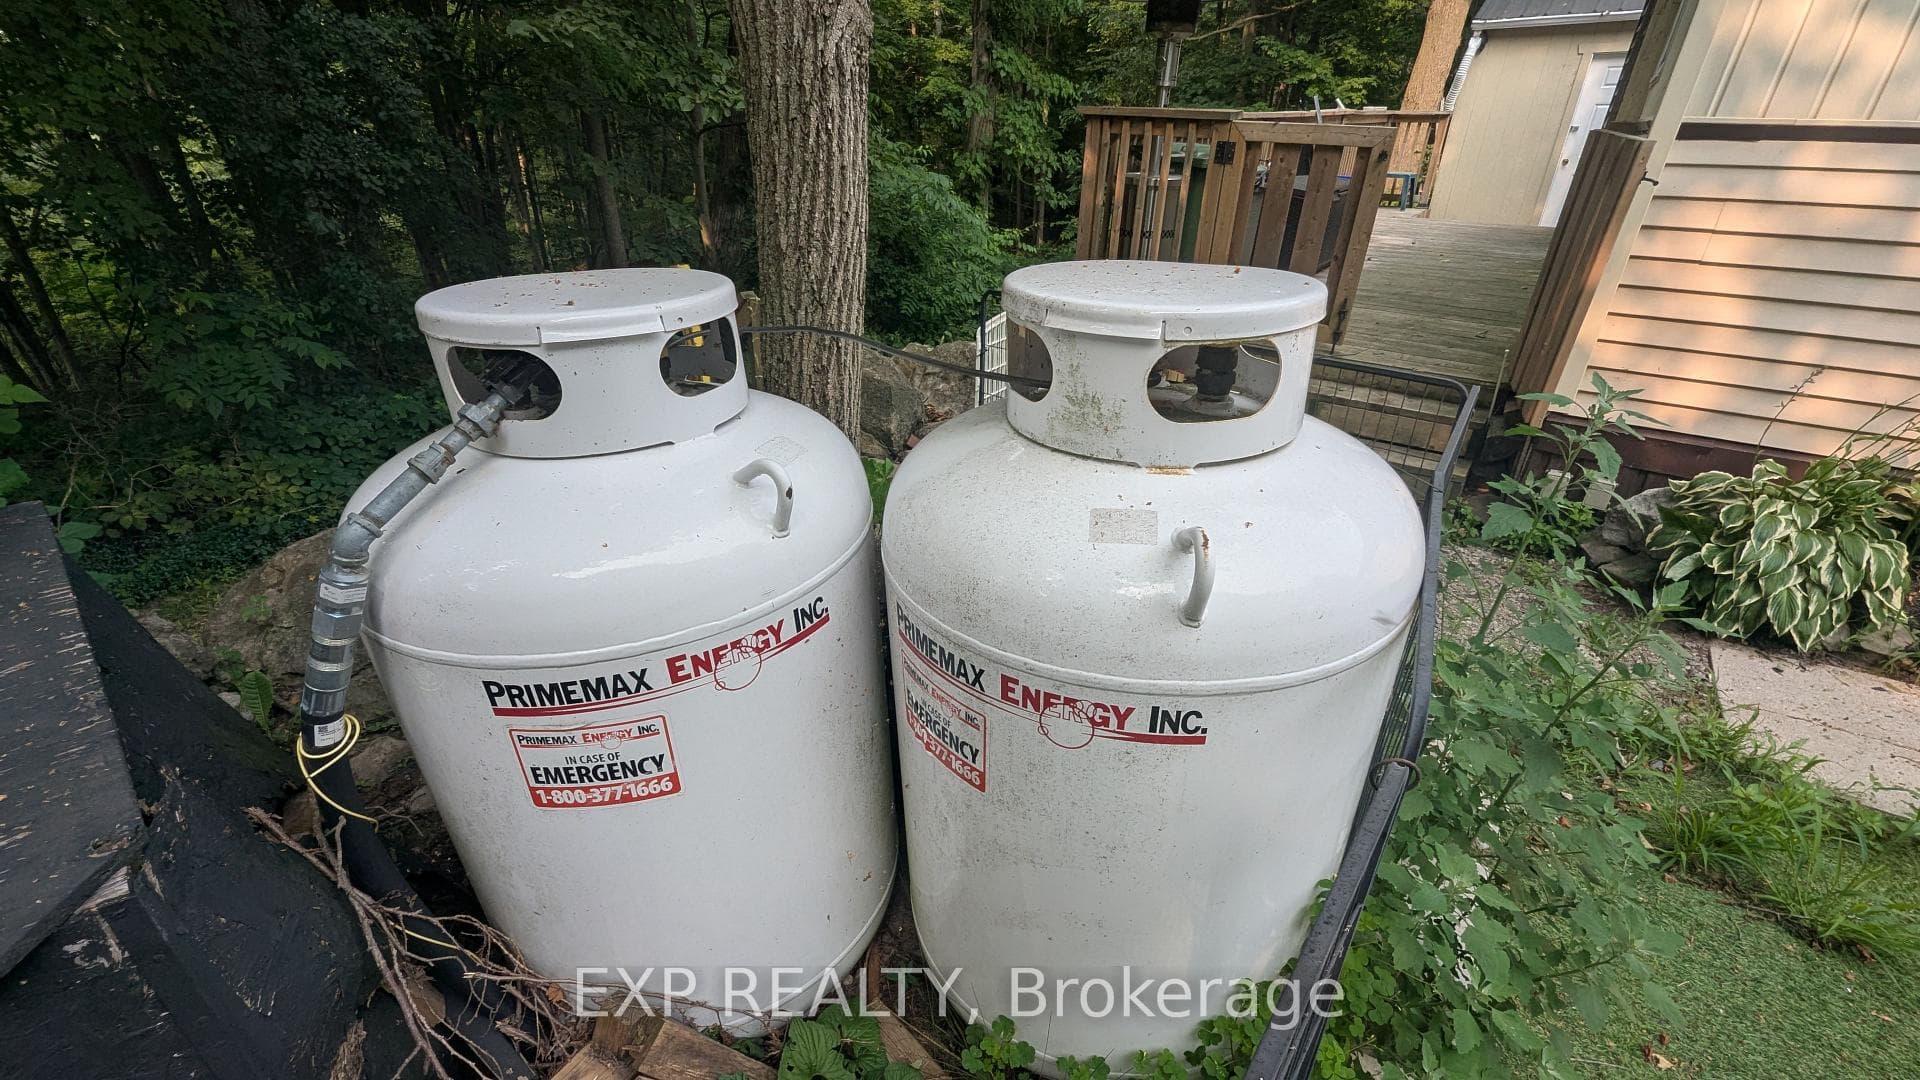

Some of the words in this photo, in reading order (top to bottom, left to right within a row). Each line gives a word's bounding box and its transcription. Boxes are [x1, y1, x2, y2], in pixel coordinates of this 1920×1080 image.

[482, 668, 653, 707] PRIMEMAX
[666, 619, 784, 684] ENERGY
[793, 596, 830, 633] INC.
[897, 601, 986, 692] PRIMEMAX
[1000, 674, 1136, 731] ENERGY
[1149, 705, 1208, 735] INC.
[928, 703, 942, 722] CASE
[943, 715, 951, 728] OF
[516, 734, 577, 745] PRIMEMAX
[637, 723, 660, 735] INC.
[530, 753, 665, 785] EMERGENCY
[565, 756, 577, 765] IN
[580, 753, 605, 764] CASE
[607, 751, 621, 762] OF
[535, 776, 674, 805] 1-800-377-1666
